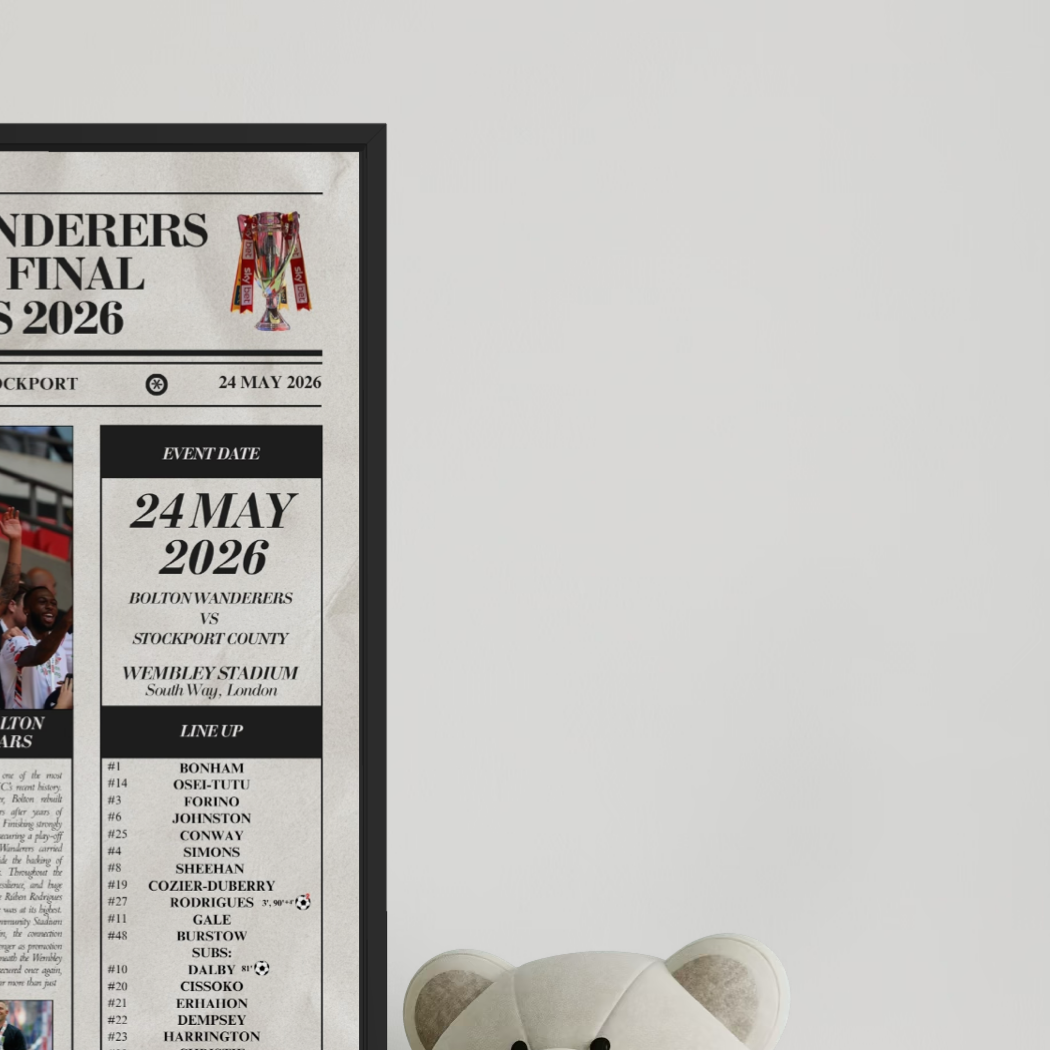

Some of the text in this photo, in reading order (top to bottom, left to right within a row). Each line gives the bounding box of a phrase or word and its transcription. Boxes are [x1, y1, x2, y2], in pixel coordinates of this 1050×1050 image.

[7, 257, 144, 291] FINAL
[23, 301, 123, 335] 2026
[219, 376, 321, 388] 24 MAY 2026
[163, 447, 260, 460] EVENT DATE
[130, 492, 299, 528] 24 MAY
[159, 540, 269, 575] 2026
[129, 592, 293, 604] BOLTON WANDERERS
[201, 613, 219, 624] VS
[133, 633, 289, 644] STOCKPORT COUNTY
[123, 666, 299, 680] WEMBLEY STADIUM
[145, 684, 278, 700] South Way, London
[181, 725, 243, 737] LINE UP
[107, 761, 243, 773] #1 BONHAM
[107, 777, 249, 789] #14 OSEI-TUTU
[107, 794, 239, 806] #3 FORINO
[107, 811, 250, 823] #6 JOHNSTON
[107, 828, 243, 840] #25 CONWAY
[107, 846, 240, 857] #4 SIMONS
[107, 862, 243, 874] #8 SHEEHAN
[107, 879, 275, 891] #19 COZIER-DUBERRY
[107, 896, 128, 907] #27
[171, 897, 254, 907] RODRIGUES
[107, 913, 231, 925] #11 GALE
[107, 930, 247, 941] #48 BURSTOW
[192, 948, 232, 958] SUBS:
[107, 964, 128, 974] #10
[189, 965, 235, 974] DALBY
[107, 981, 243, 991] #20 CISSOKO
[107, 997, 247, 1008] #21 ERHAHON
[107, 1014, 246, 1025] #22 DEMPSEY
[107, 1031, 259, 1042] #23 HARRINGTON
